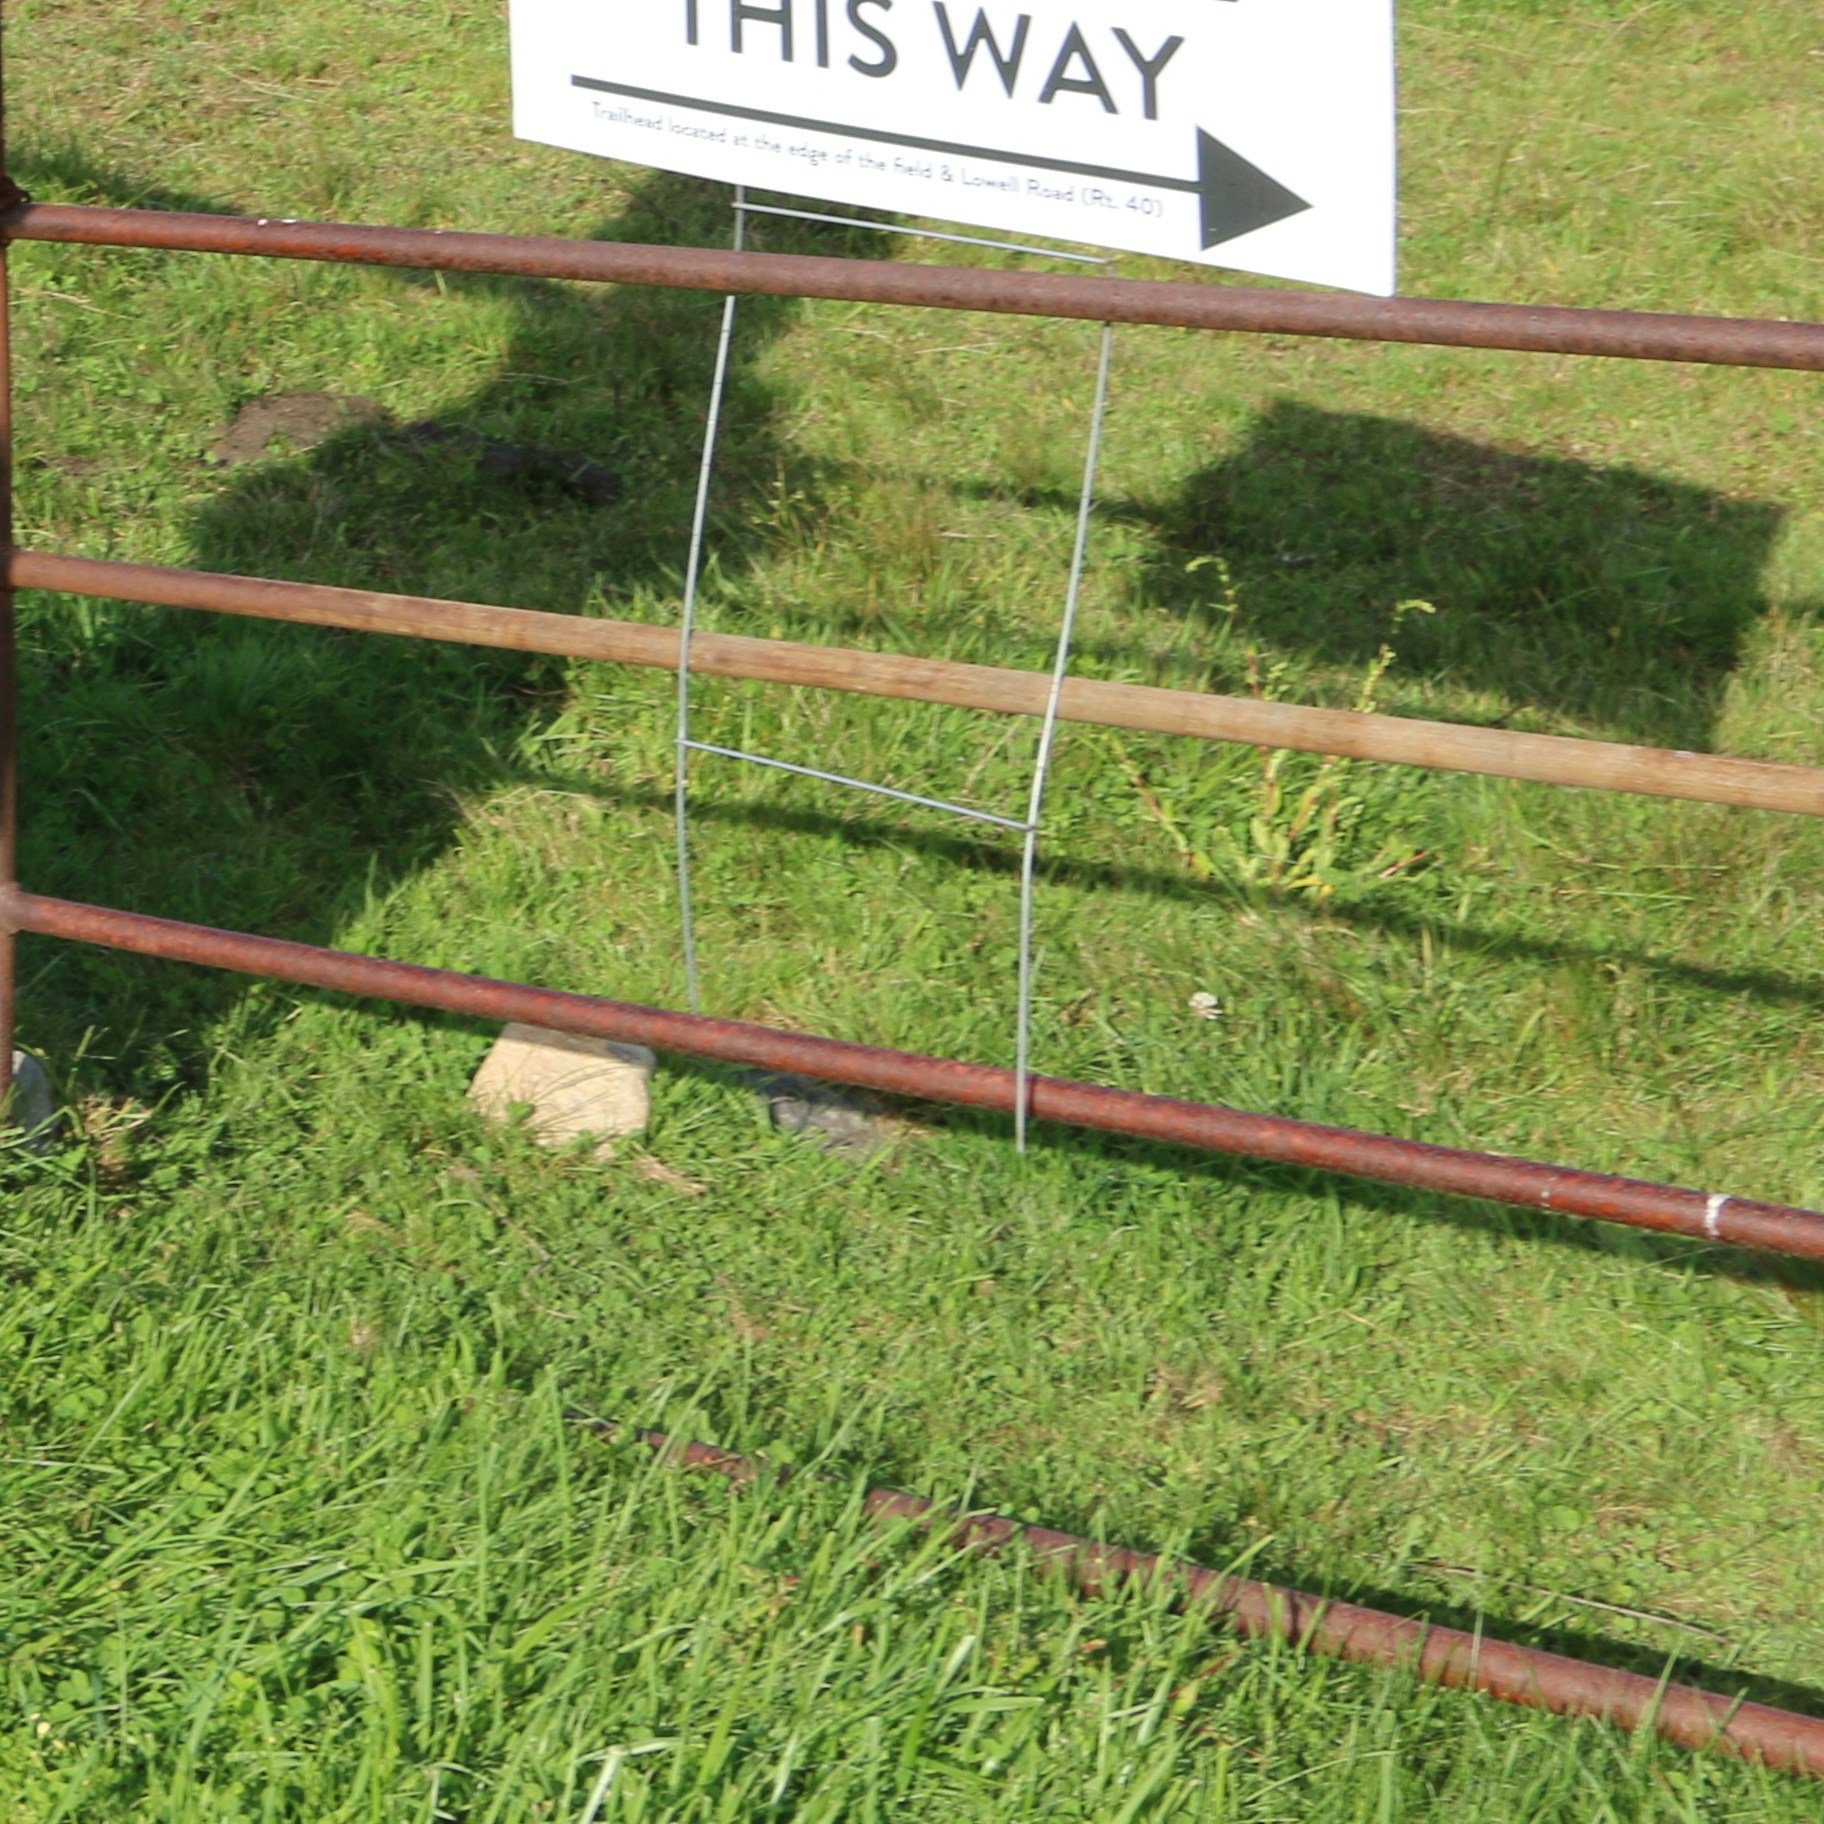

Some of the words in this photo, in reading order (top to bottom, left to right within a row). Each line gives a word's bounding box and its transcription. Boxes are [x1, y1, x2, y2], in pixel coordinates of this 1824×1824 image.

[933, 0, 1184, 121] WAY
[591, 101, 663, 131] Trailhead
[668, 116, 726, 143] located
[732, 133, 748, 147] at
[755, 134, 782, 154] the
[788, 142, 828, 166] edge
[834, 148, 853, 165] of
[858, 153, 886, 172] the
[893, 157, 933, 179] field
[940, 164, 953, 182] &
[961, 168, 1020, 193] Lowell
[1027, 178, 1075, 202] Road
[1081, 186, 1118, 210] (Rt.
[1125, 194, 1164, 218] 40)
